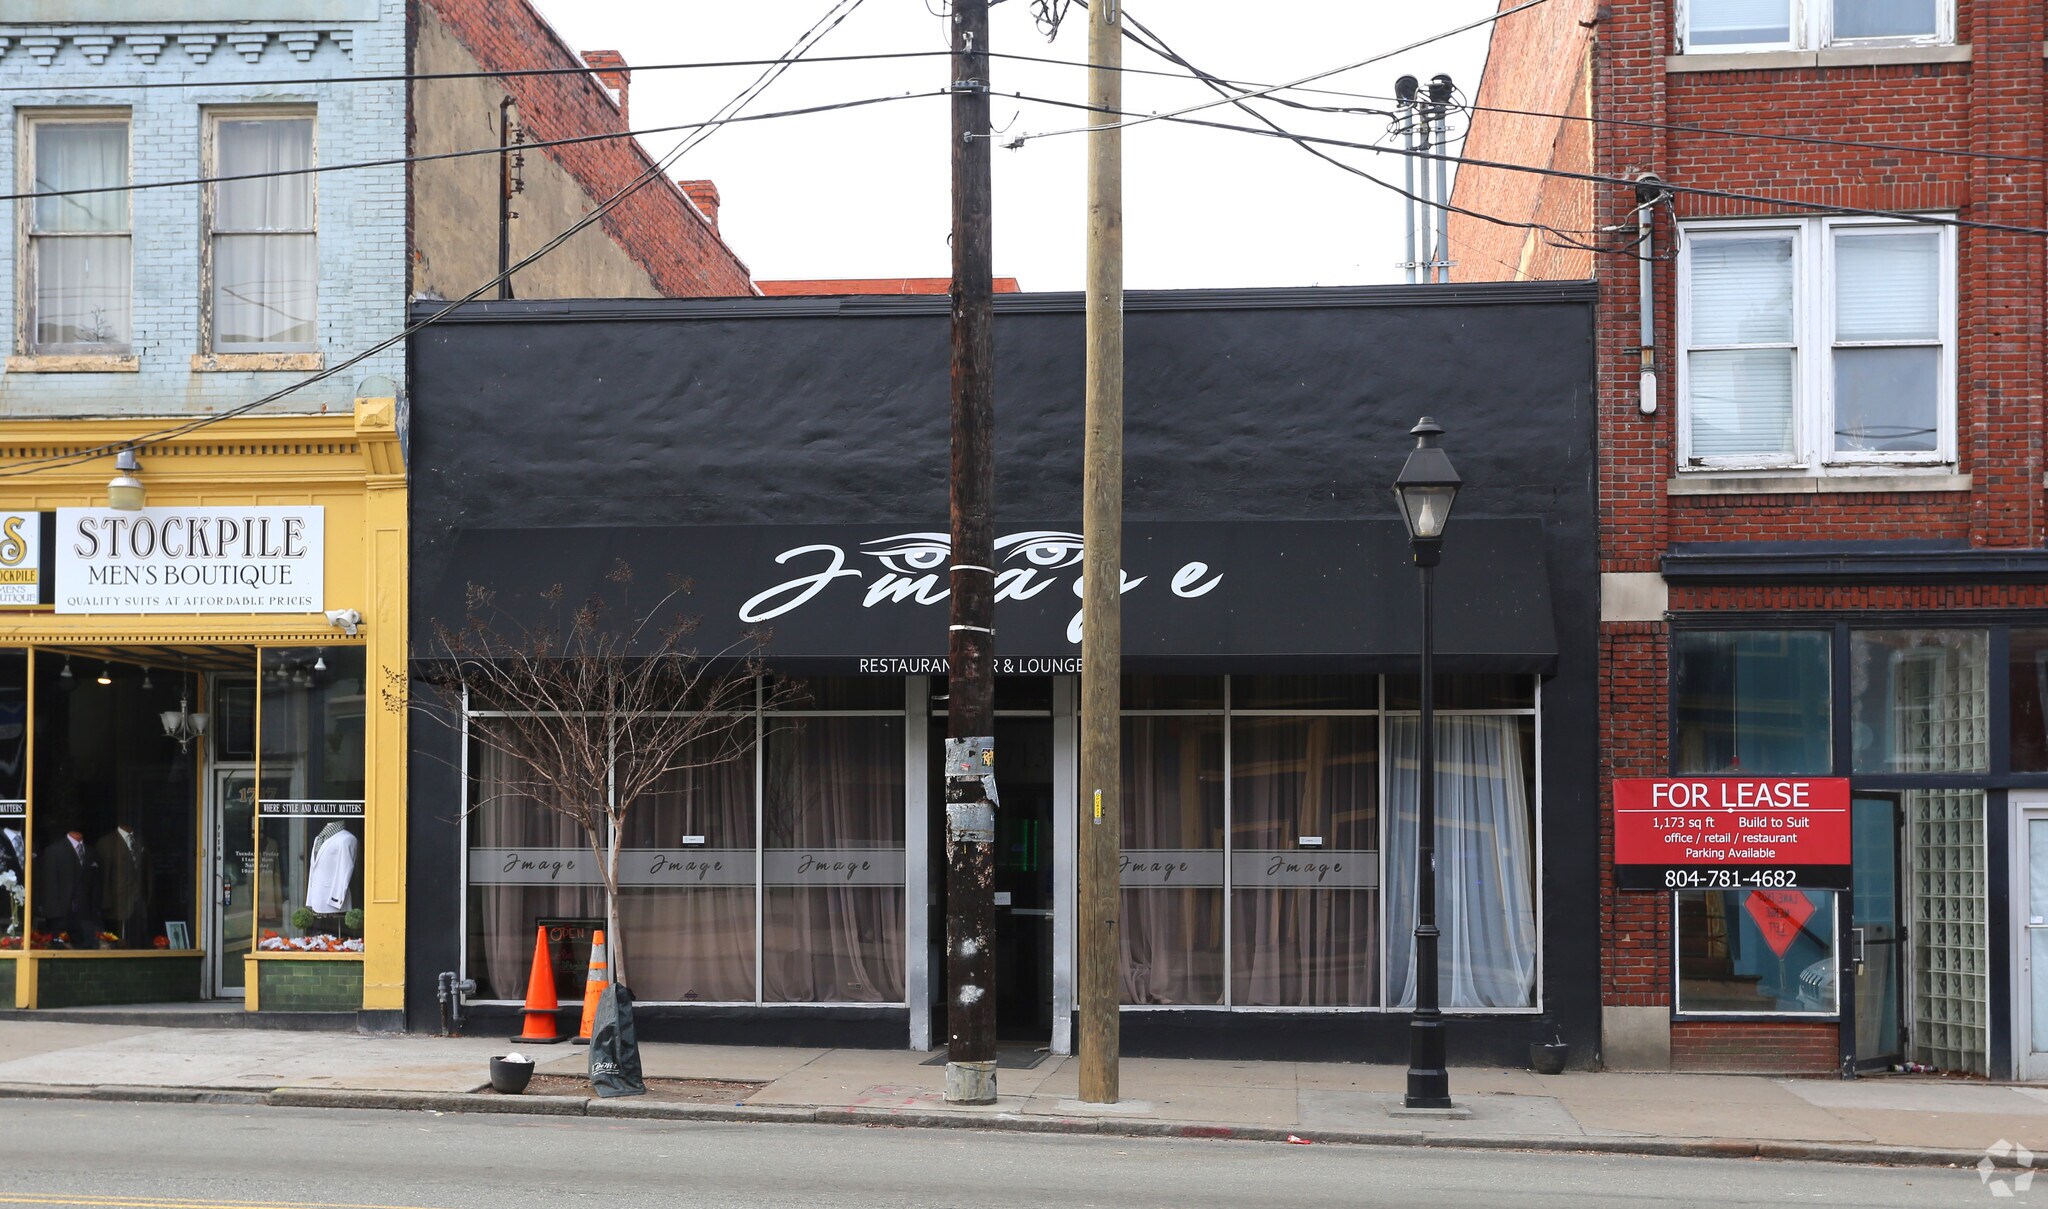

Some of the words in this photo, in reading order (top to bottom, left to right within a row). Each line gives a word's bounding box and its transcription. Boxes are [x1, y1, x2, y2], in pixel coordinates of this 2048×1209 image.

[0, 516, 27, 567] S
[73, 516, 307, 559] STOCKPILE
[88, 565, 158, 586] MEN'S
[164, 565, 293, 589] BOUTIQUE
[67, 597, 120, 606] QUALITY
[125, 597, 160, 606] SUITS
[165, 597, 180, 606] AT
[184, 597, 265, 606] AFFORDABLE
[269, 596, 312, 606] PRICES
[859, 658, 950, 673] RESTAURAN
[1003, 658, 1015, 673] &
[1019, 658, 1083, 673] LOUNGE
[1652, 783, 1711, 808] FOR
[1721, 783, 1809, 808] LEASE
[263, 804, 280, 813] WHERE
[282, 804, 299, 813] STYLE
[301, 804, 312, 813] AND
[313, 804, 336, 813] QUALITY
[338, 804, 362, 813] MATTERS
[1653, 817, 1685, 829] 1,173
[1688, 820, 1702, 829] sq
[1705, 816, 1715, 828] ft
[1739, 816, 1767, 828] Build
[1771, 817, 1783, 828] to
[1786, 816, 1809, 828] Suit
[1664, 833, 1693, 843] office
[1695, 833, 1701, 844] /
[1704, 833, 1731, 843] retail
[1733, 833, 1739, 844] /
[1742, 833, 1797, 843] restaurant
[1685, 848, 1725, 860] Parking
[1728, 848, 1776, 858] Available
[1665, 870, 1797, 888] 804-781-4682
[550, 927, 584, 941] OPEN
